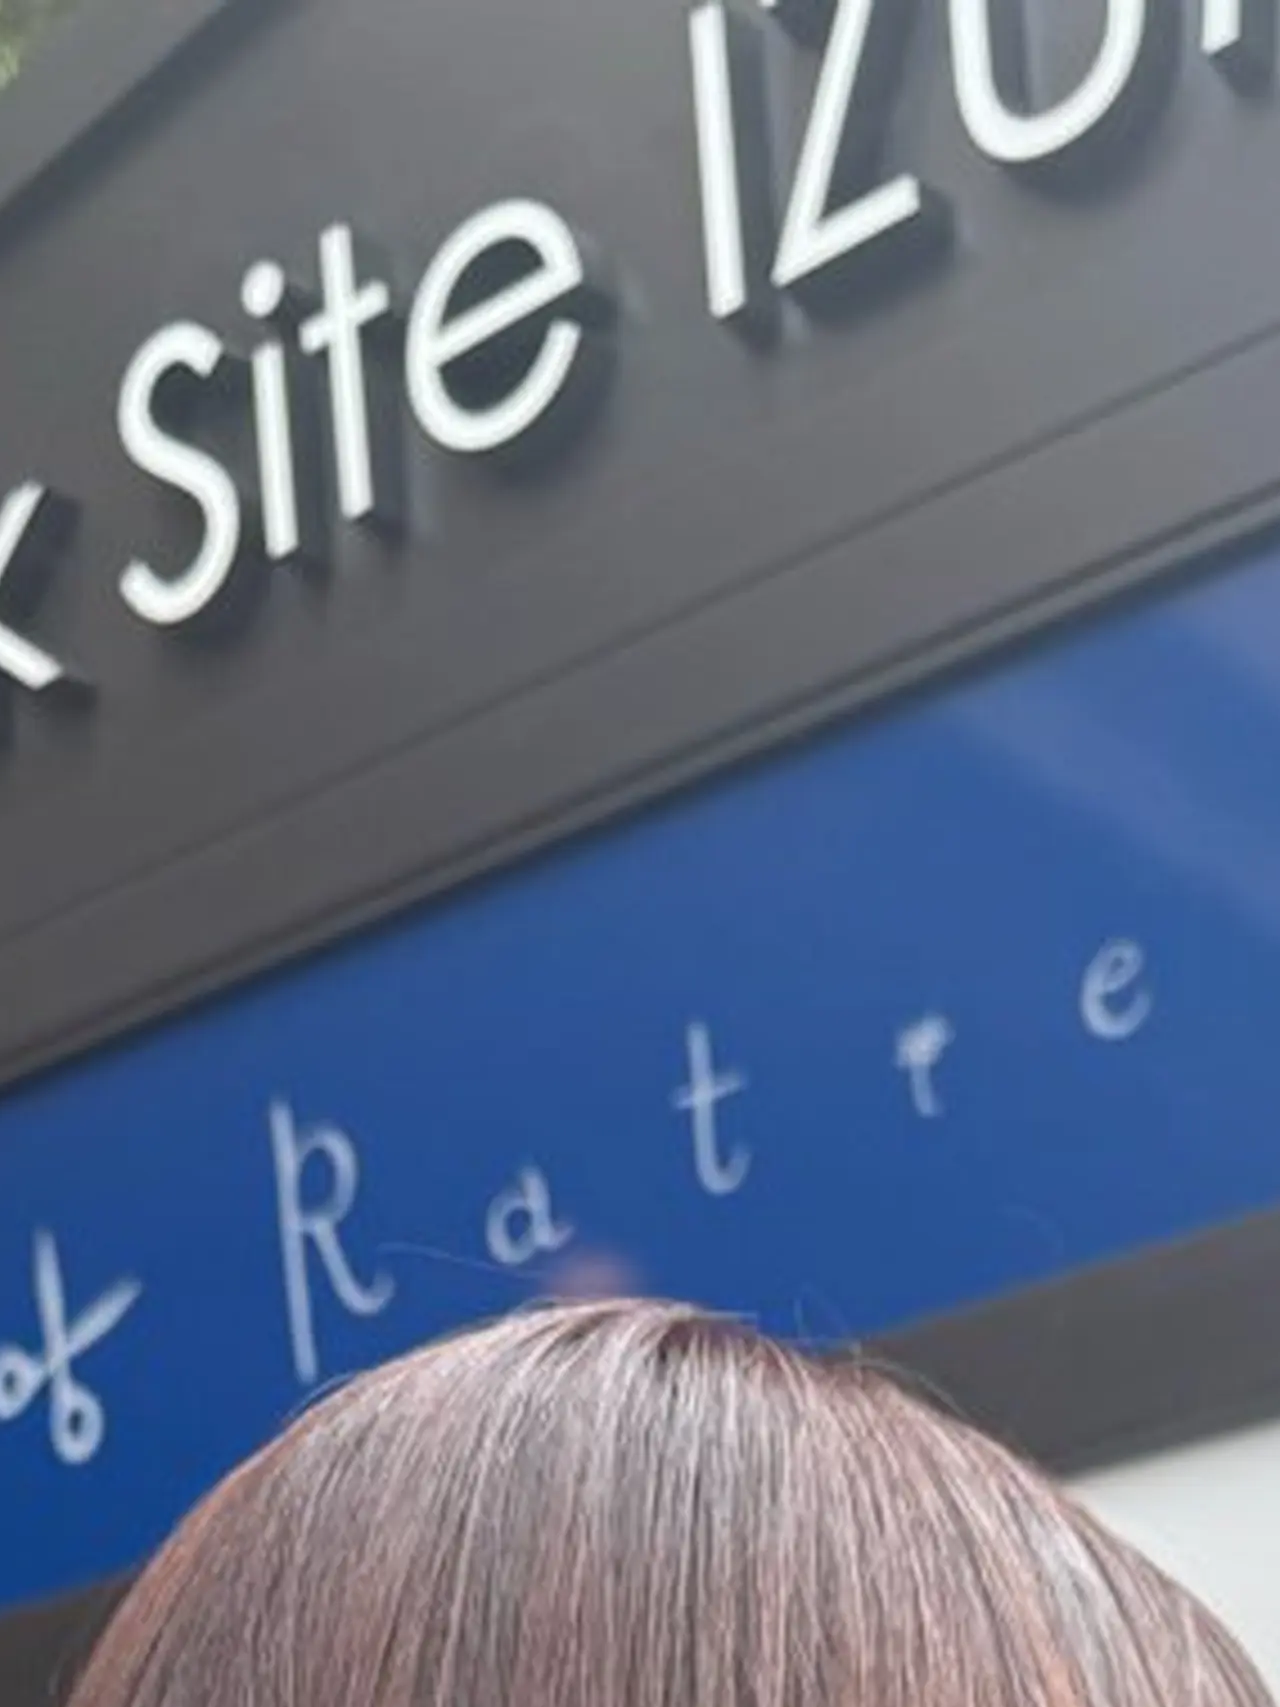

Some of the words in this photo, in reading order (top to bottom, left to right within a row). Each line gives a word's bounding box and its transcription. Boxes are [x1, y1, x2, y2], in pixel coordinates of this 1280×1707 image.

[117, 200, 585, 626] Site
[687, 0, 1241, 319] IZU
[268, 938, 1152, 1385] Ratre
